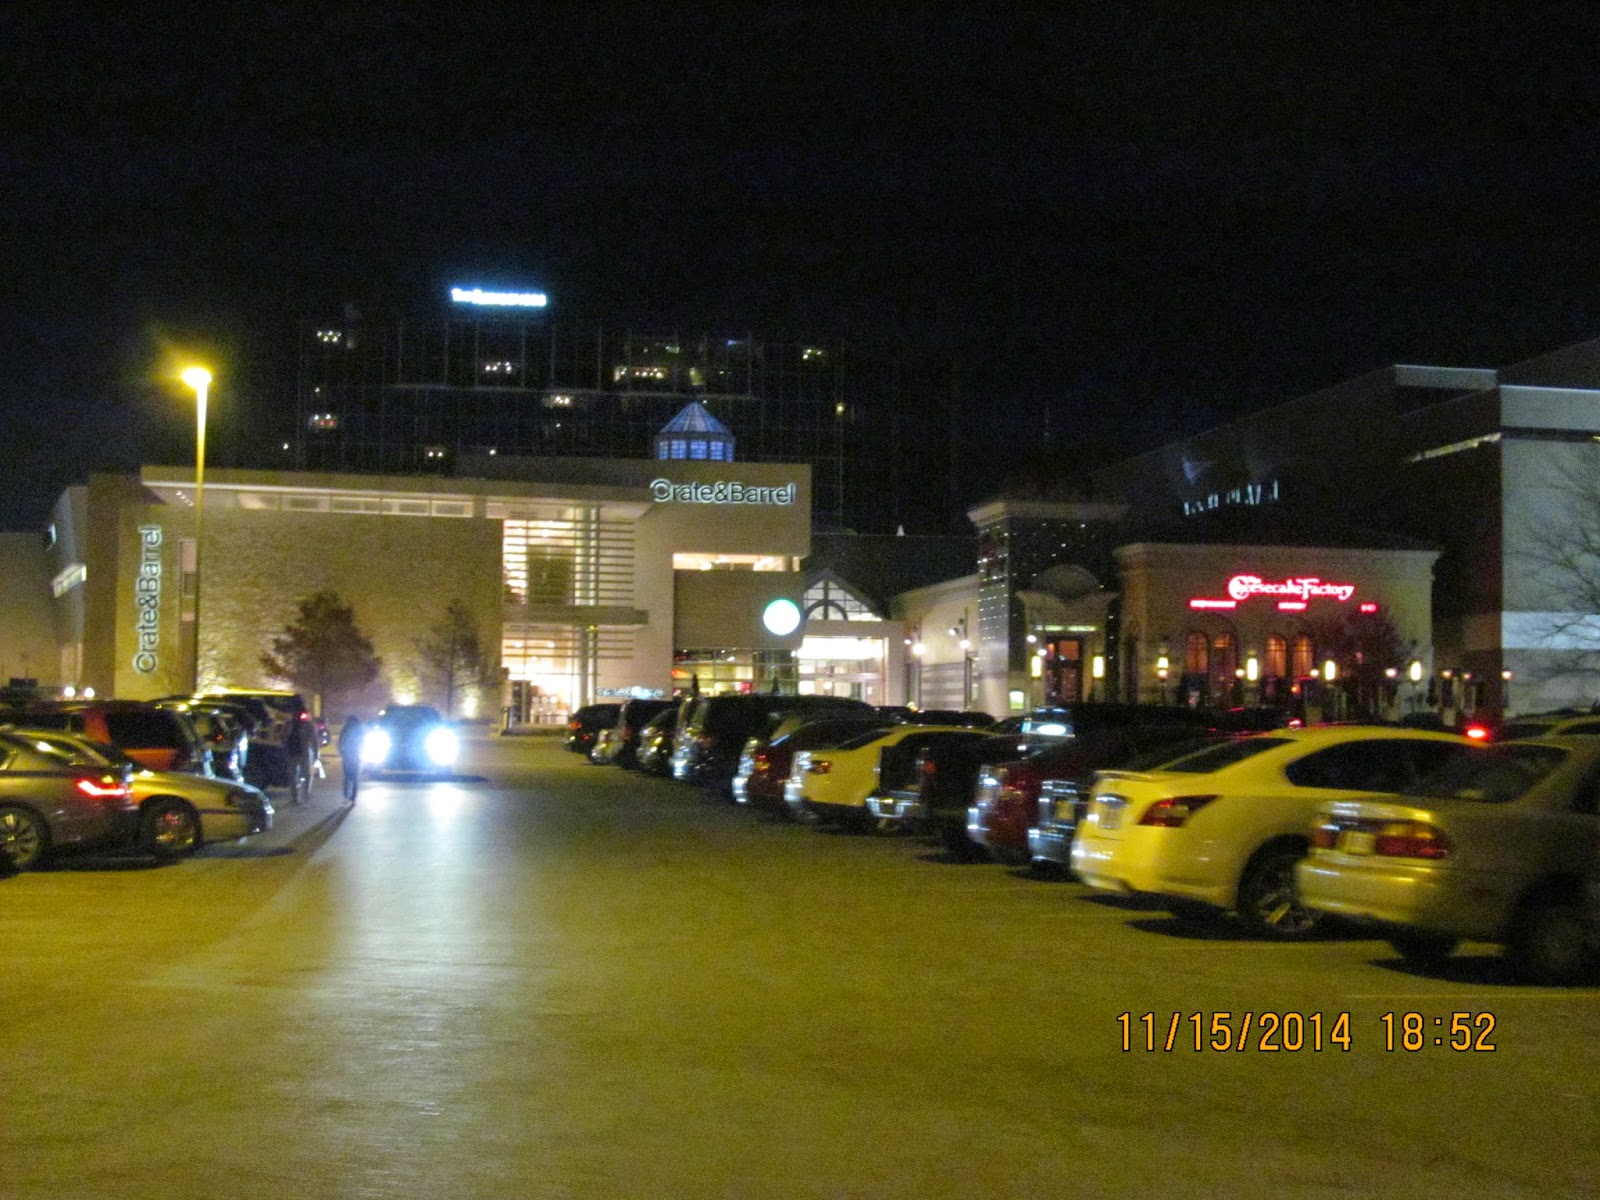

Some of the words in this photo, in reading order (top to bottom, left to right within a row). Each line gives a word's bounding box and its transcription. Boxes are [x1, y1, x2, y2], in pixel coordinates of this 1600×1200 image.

[650, 478, 796, 505] Crate&Barrel
[133, 524, 162, 674] Crate&Barrel
[1296, 578, 1355, 600] Factory
